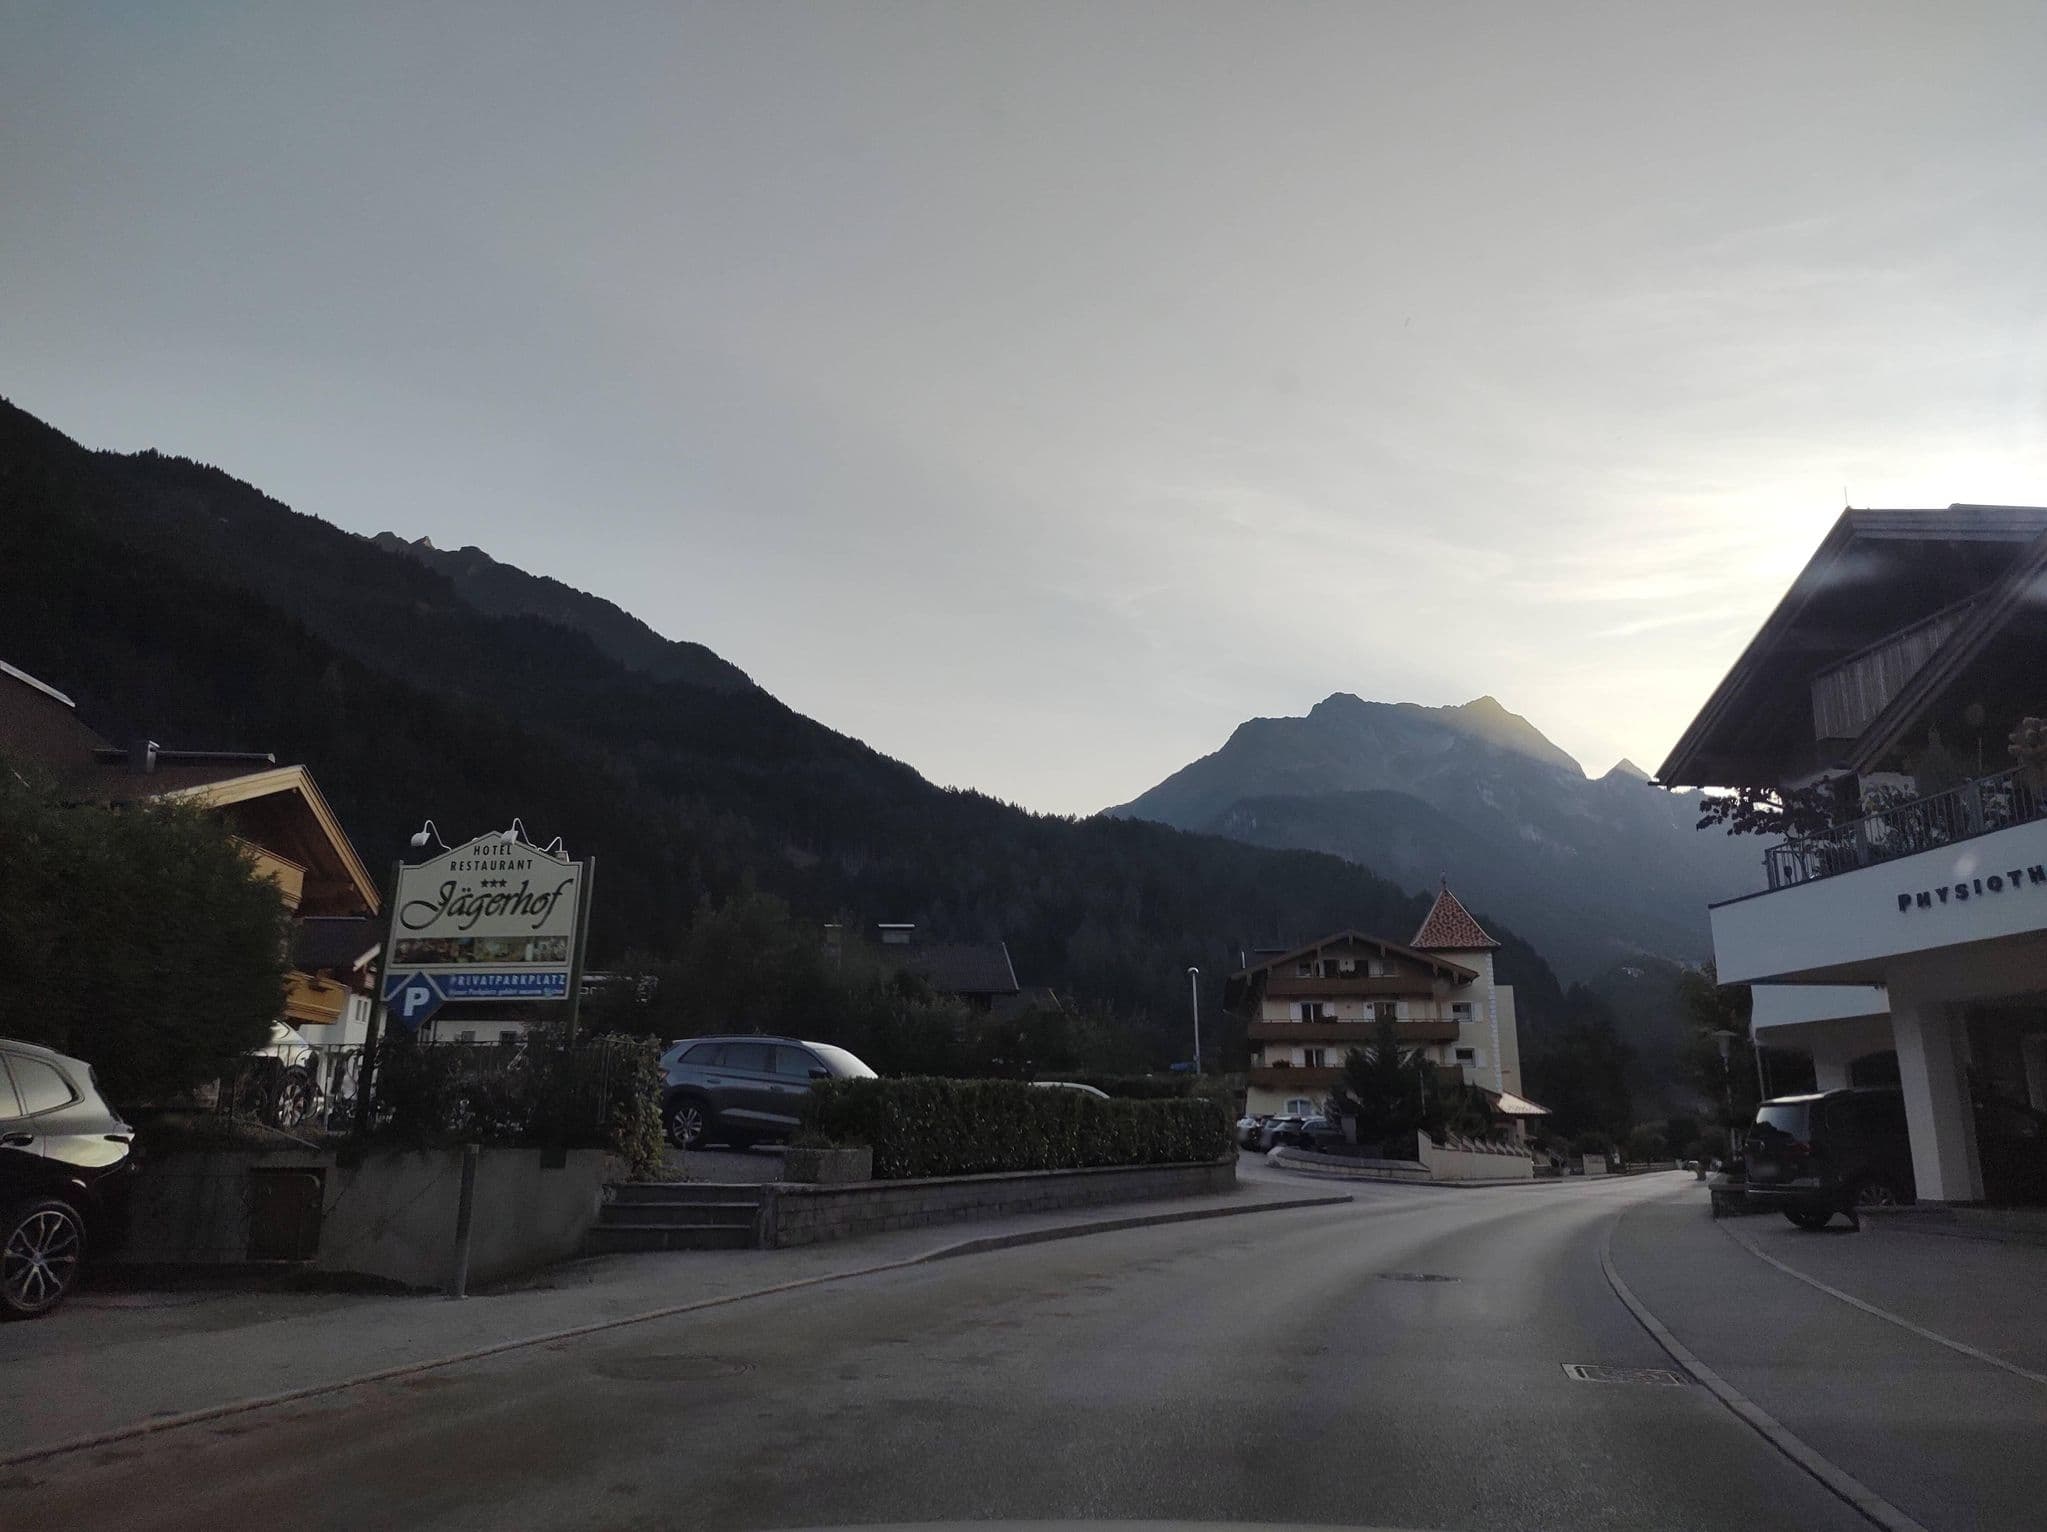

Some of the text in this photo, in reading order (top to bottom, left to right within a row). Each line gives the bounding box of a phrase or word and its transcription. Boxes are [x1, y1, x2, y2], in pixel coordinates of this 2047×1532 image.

[473, 845, 512, 856] HOTEL
[450, 859, 534, 872] RESTAURANT
[1897, 864, 2047, 913] PHYSIOTH
[400, 878, 575, 931] Jägerhof
[449, 974, 566, 986] PRIVATPARKPLATZ
[403, 986, 431, 1017] P
